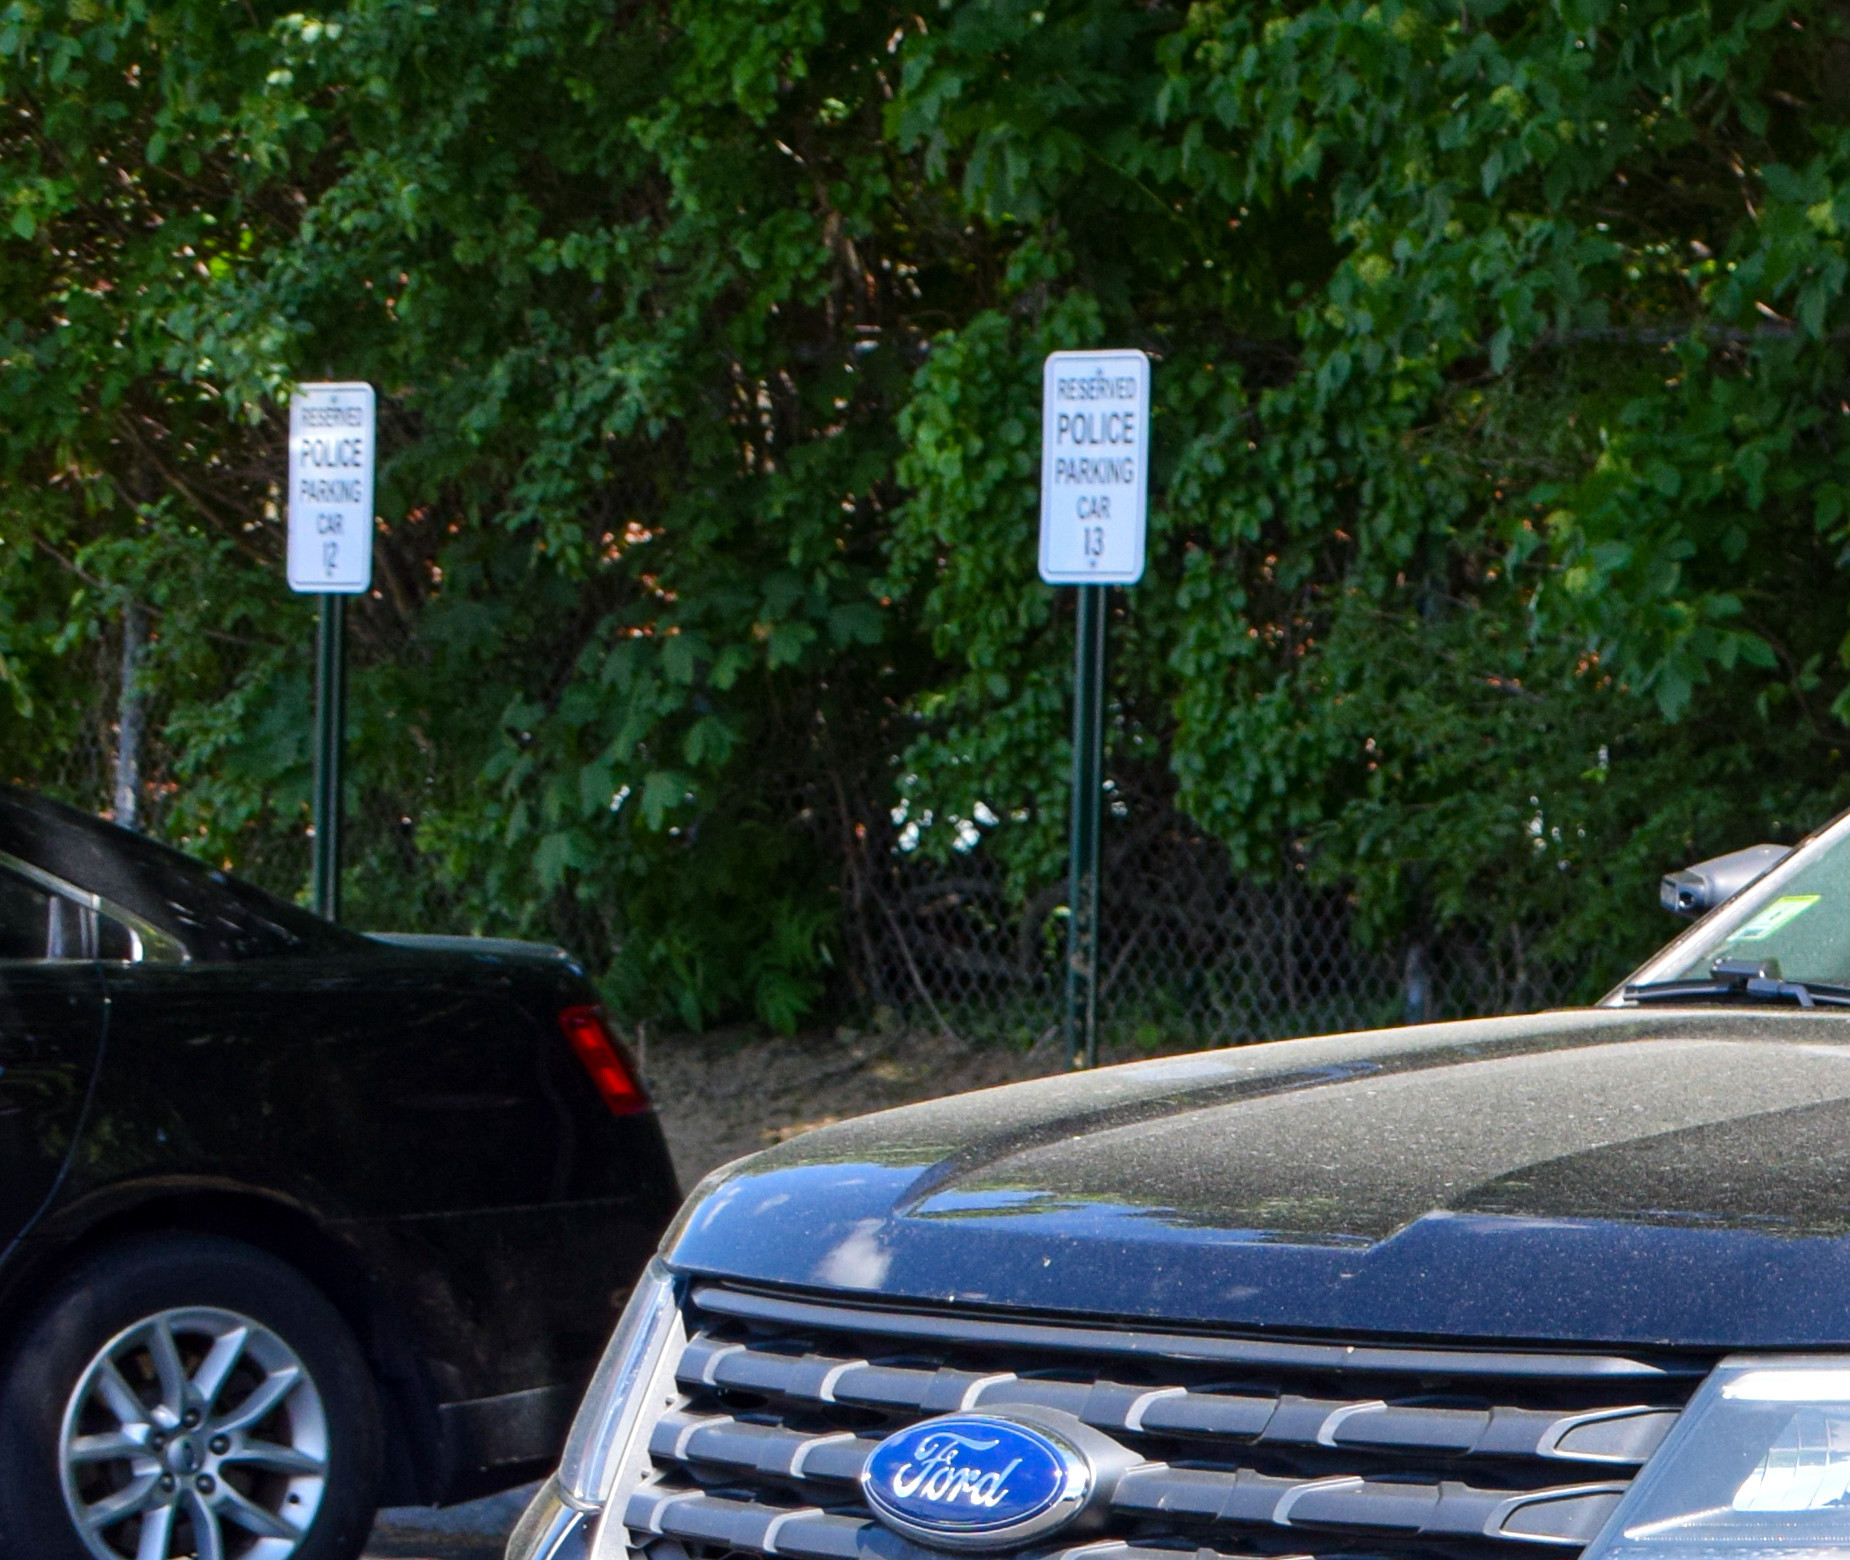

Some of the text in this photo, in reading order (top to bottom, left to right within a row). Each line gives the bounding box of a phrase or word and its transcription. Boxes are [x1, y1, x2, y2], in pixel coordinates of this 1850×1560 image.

[1056, 376, 1138, 401] RESERVED
[301, 406, 363, 428] RESERVED
[1056, 411, 1135, 445] POLICE
[301, 437, 363, 468] POLICE
[1054, 457, 1135, 485] PARKING
[300, 478, 363, 504] PARKING
[1075, 495, 1111, 520] CAR
[316, 512, 344, 536] CAR
[322, 540, 338, 569] 12
[1083, 527, 1105, 556] 13
[893, 1432, 1024, 1507] Ford
